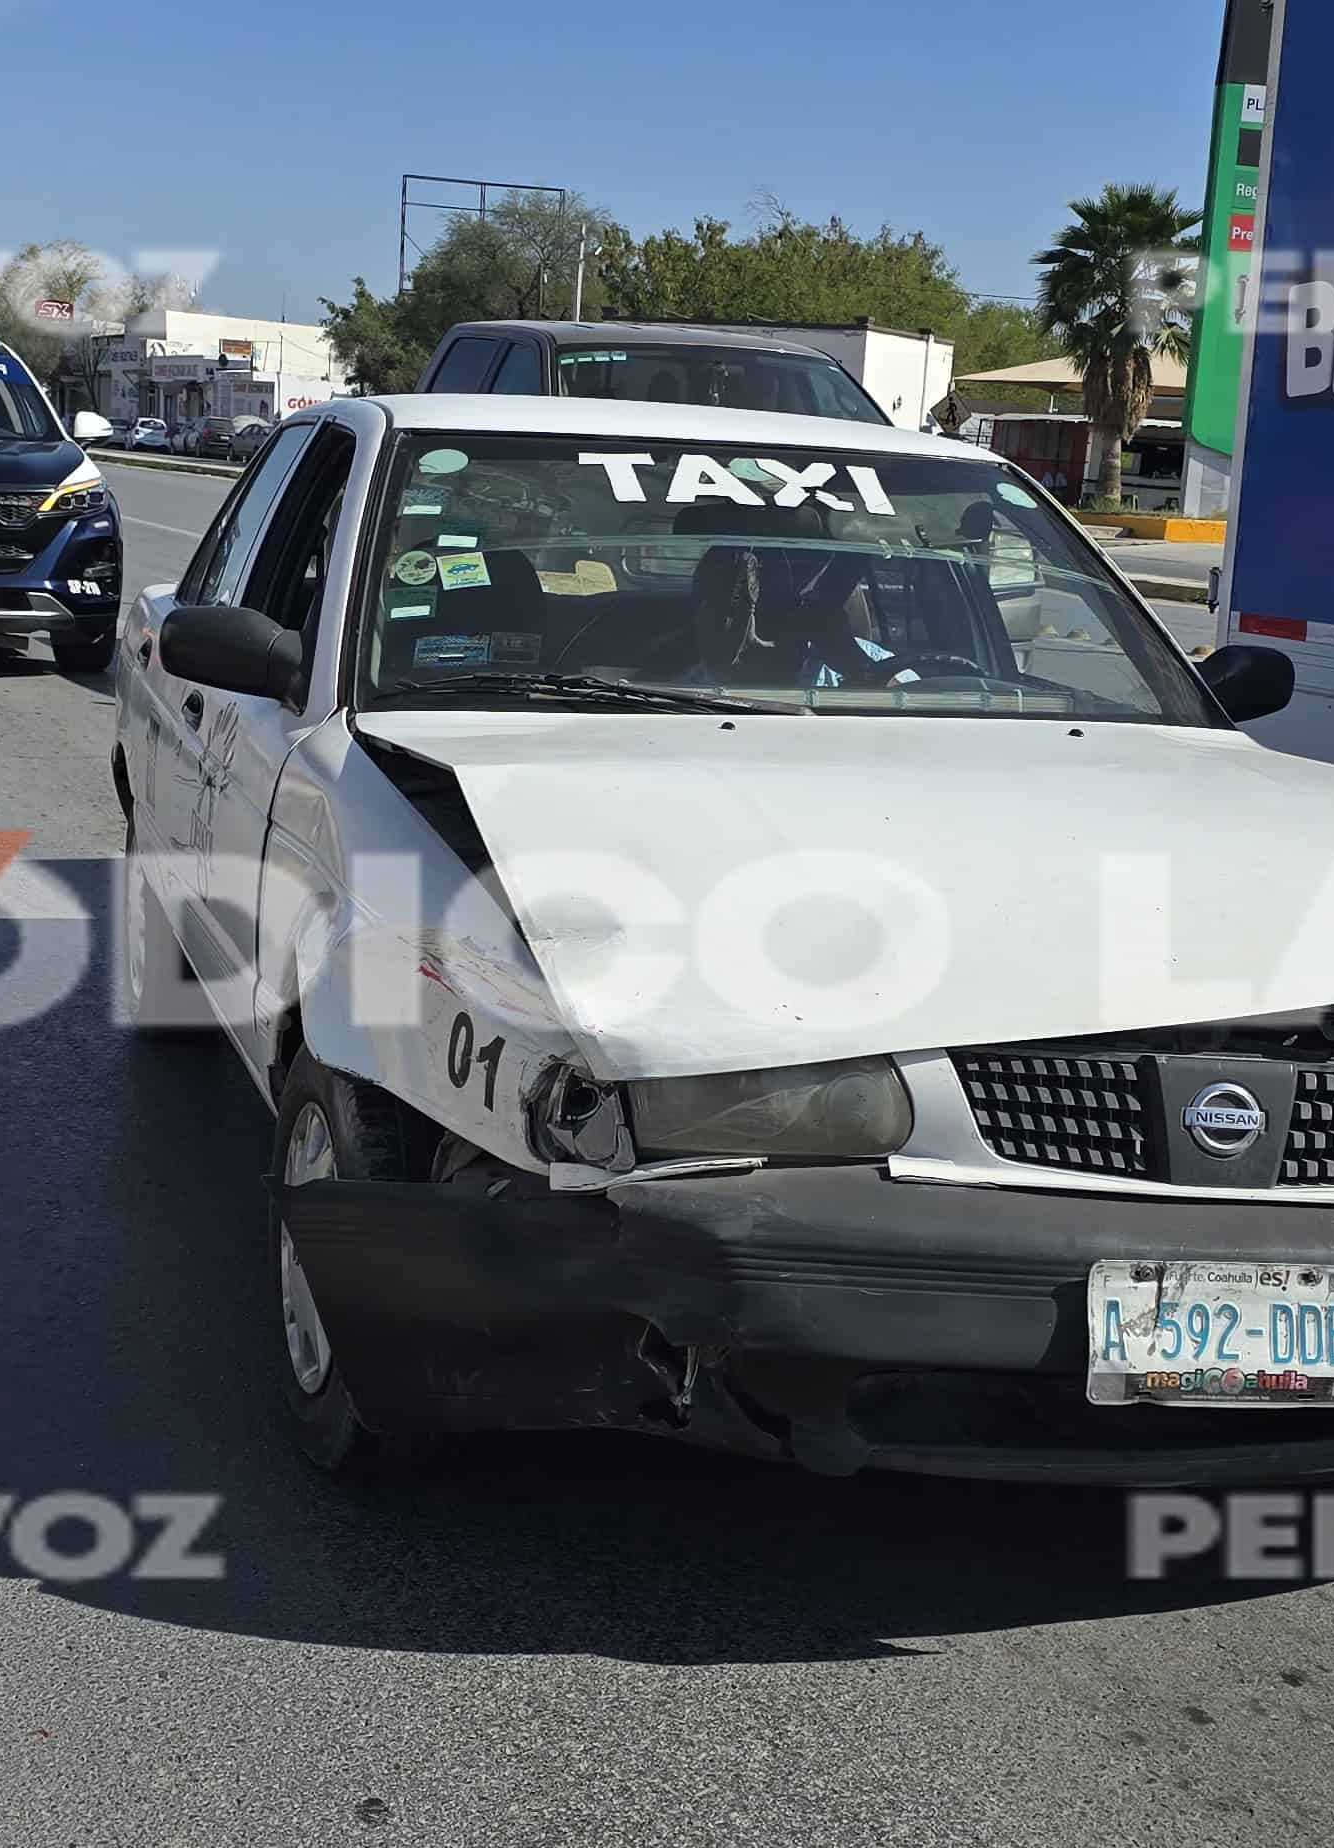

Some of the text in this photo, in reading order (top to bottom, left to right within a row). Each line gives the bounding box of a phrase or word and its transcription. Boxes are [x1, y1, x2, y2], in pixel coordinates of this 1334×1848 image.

[1246, 97, 1265, 111] PL
[578, 452, 896, 516] TAXI
[448, 1011, 506, 1113] 01
[1195, 1111, 1259, 1126] NISSAN
[1207, 1271, 1253, 1284] Coahuila
